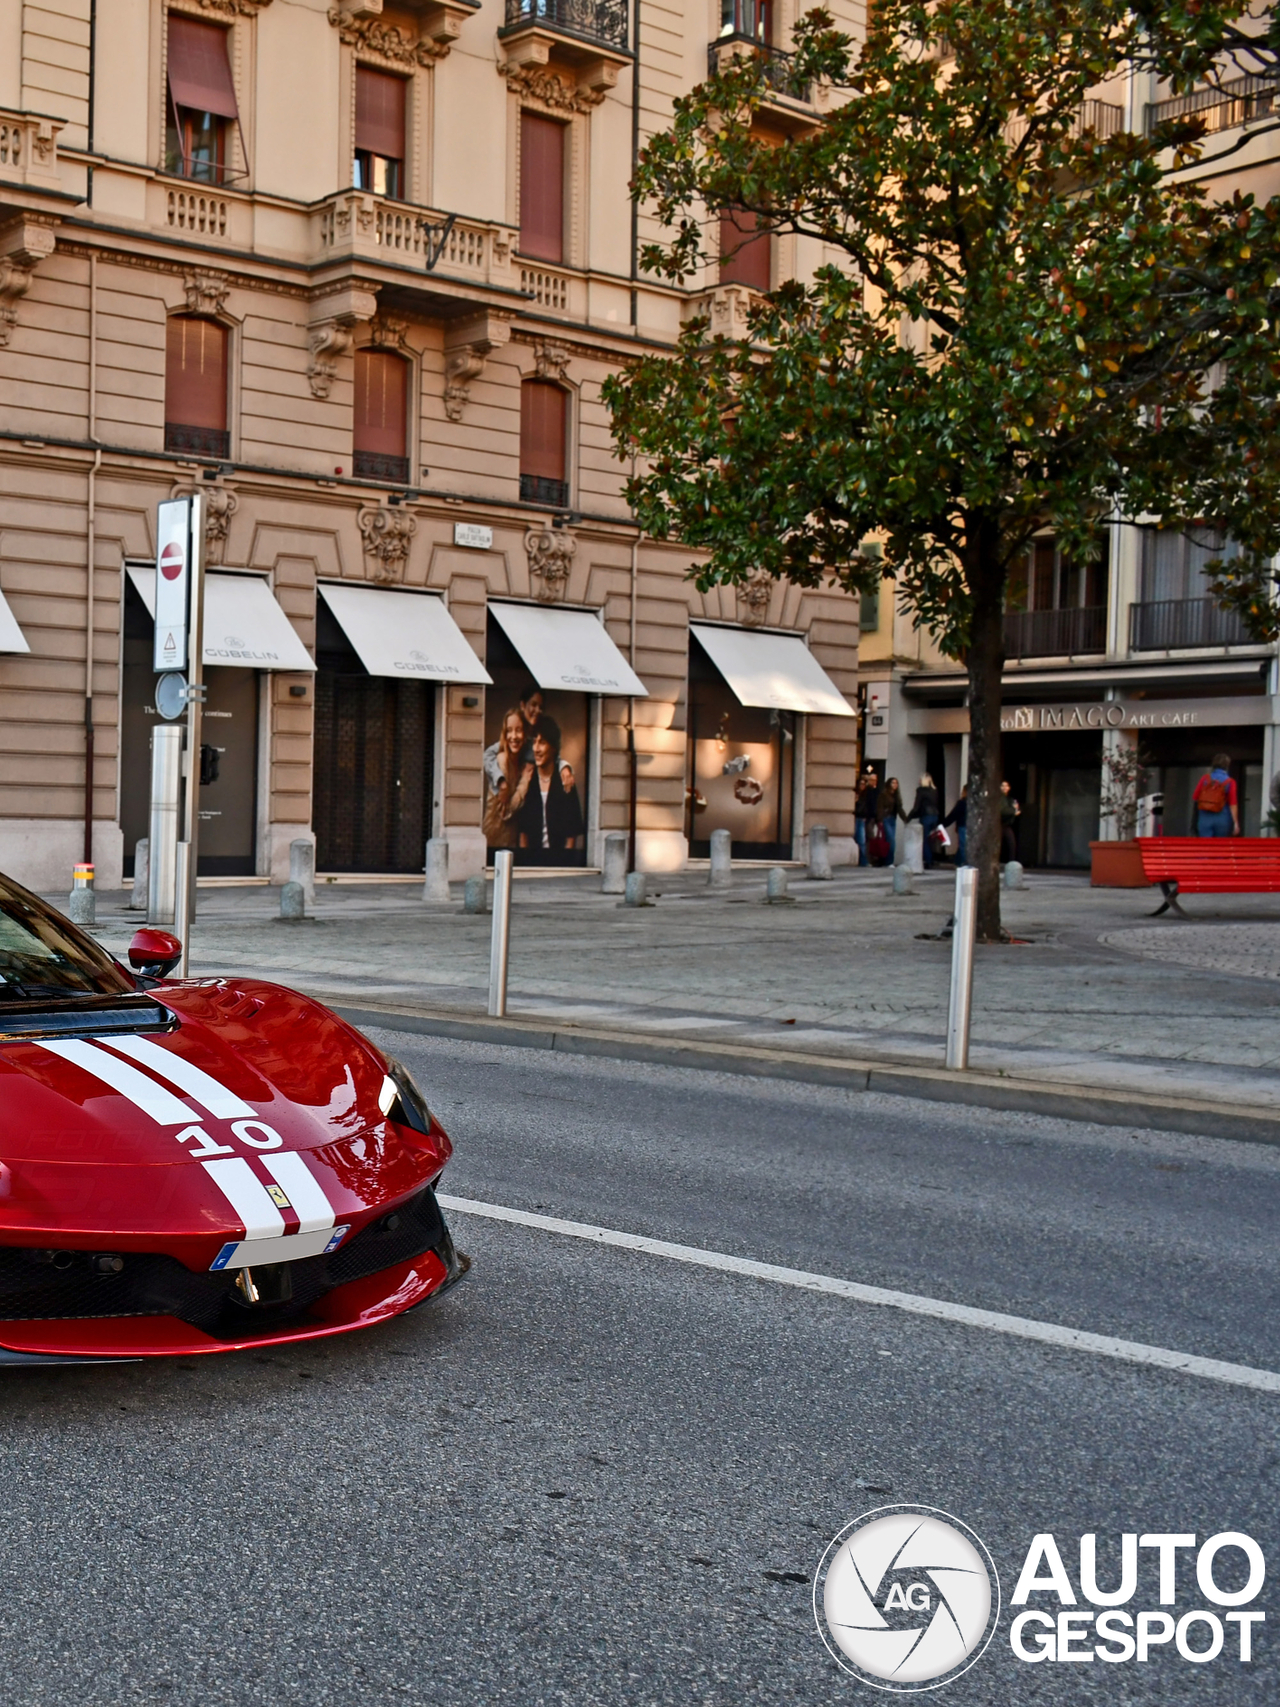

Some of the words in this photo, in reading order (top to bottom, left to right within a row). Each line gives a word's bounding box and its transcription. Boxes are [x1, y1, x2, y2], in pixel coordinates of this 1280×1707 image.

[204, 648, 280, 661] GÜBELIN
[394, 661, 460, 674] GÜBELIN
[561, 675, 619, 687] GÜBELIN
[1039, 706, 1126, 728] IMAGO
[1129, 713, 1157, 726] ART
[174, 1120, 283, 1158] 10
